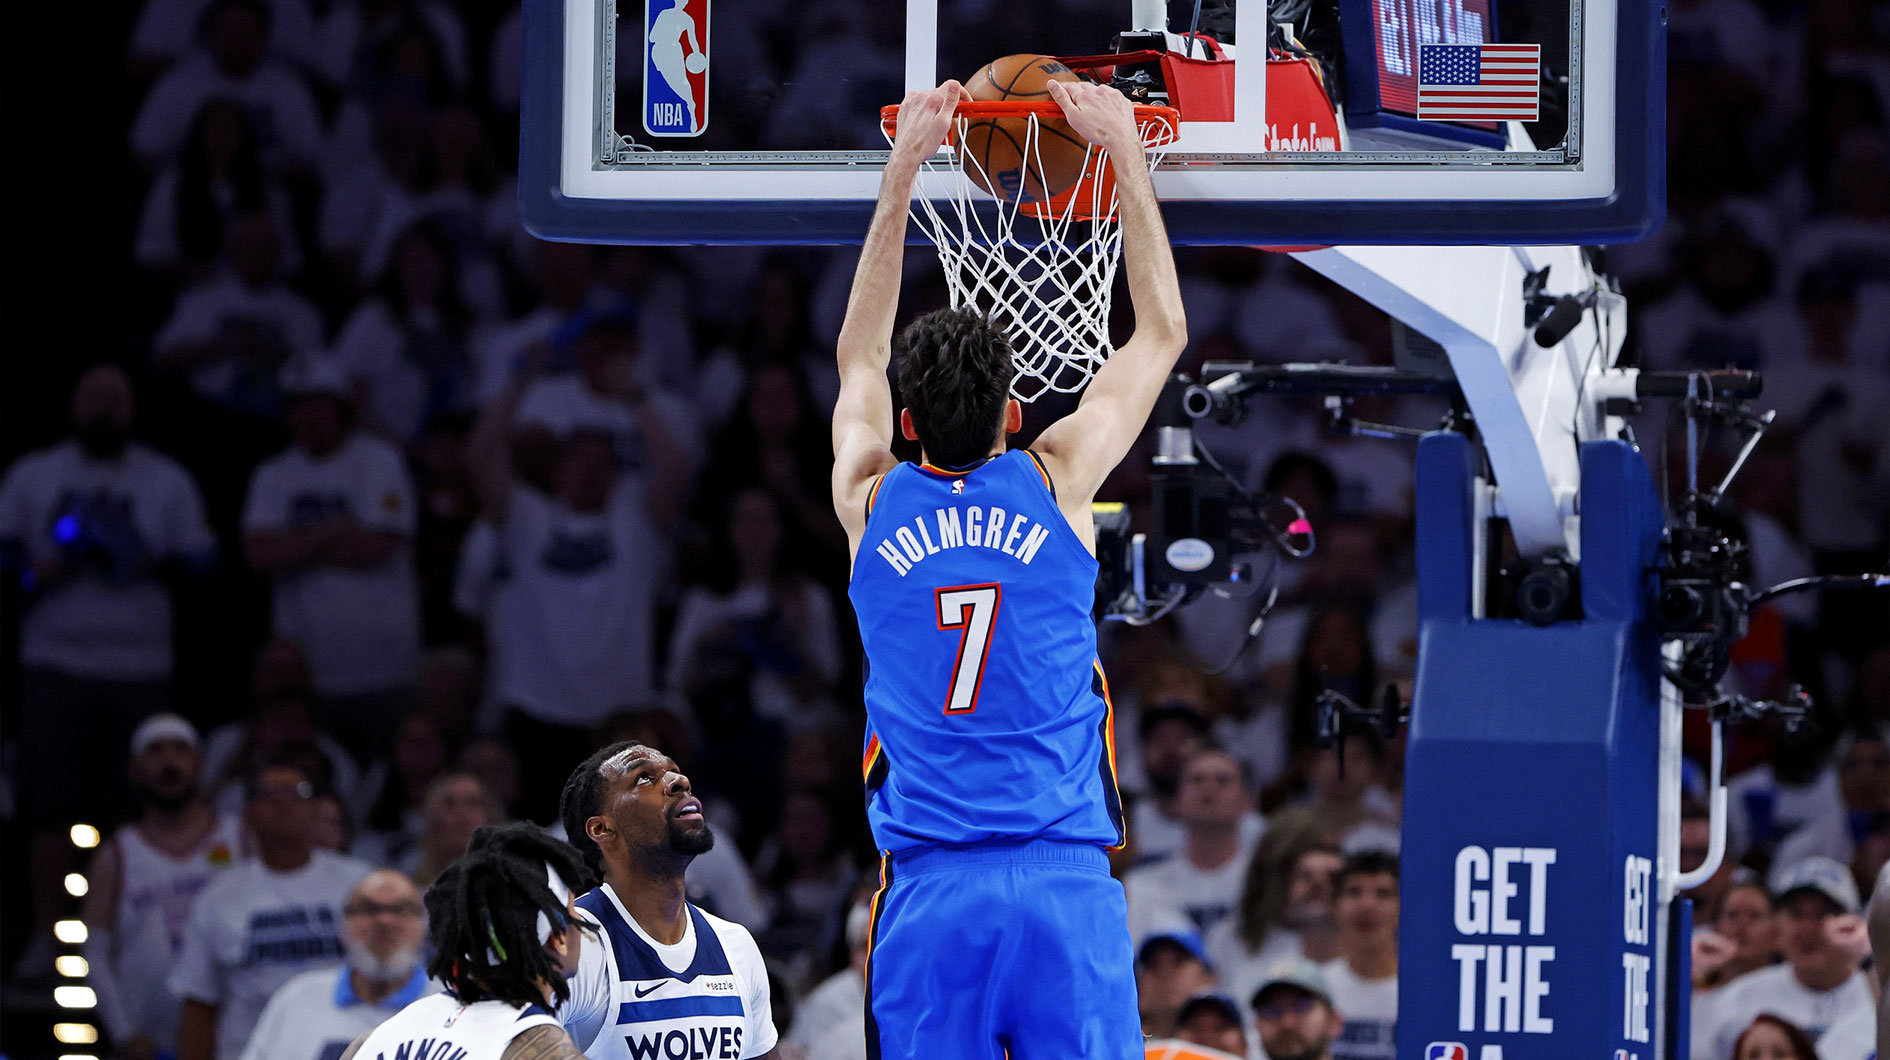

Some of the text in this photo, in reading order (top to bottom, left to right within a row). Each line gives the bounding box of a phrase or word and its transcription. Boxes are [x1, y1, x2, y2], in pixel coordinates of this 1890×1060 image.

[653, 103, 683, 126] NBA
[876, 506, 1050, 577] HOLMGREN
[934, 582, 1002, 715] 7
[1454, 845, 1557, 936] GET
[1624, 854, 1652, 946] GET
[711, 980, 733, 990] sezzle
[1451, 944, 1556, 1034] THE
[1622, 952, 1650, 1043] THE
[624, 1026, 743, 1060] WOLVES
